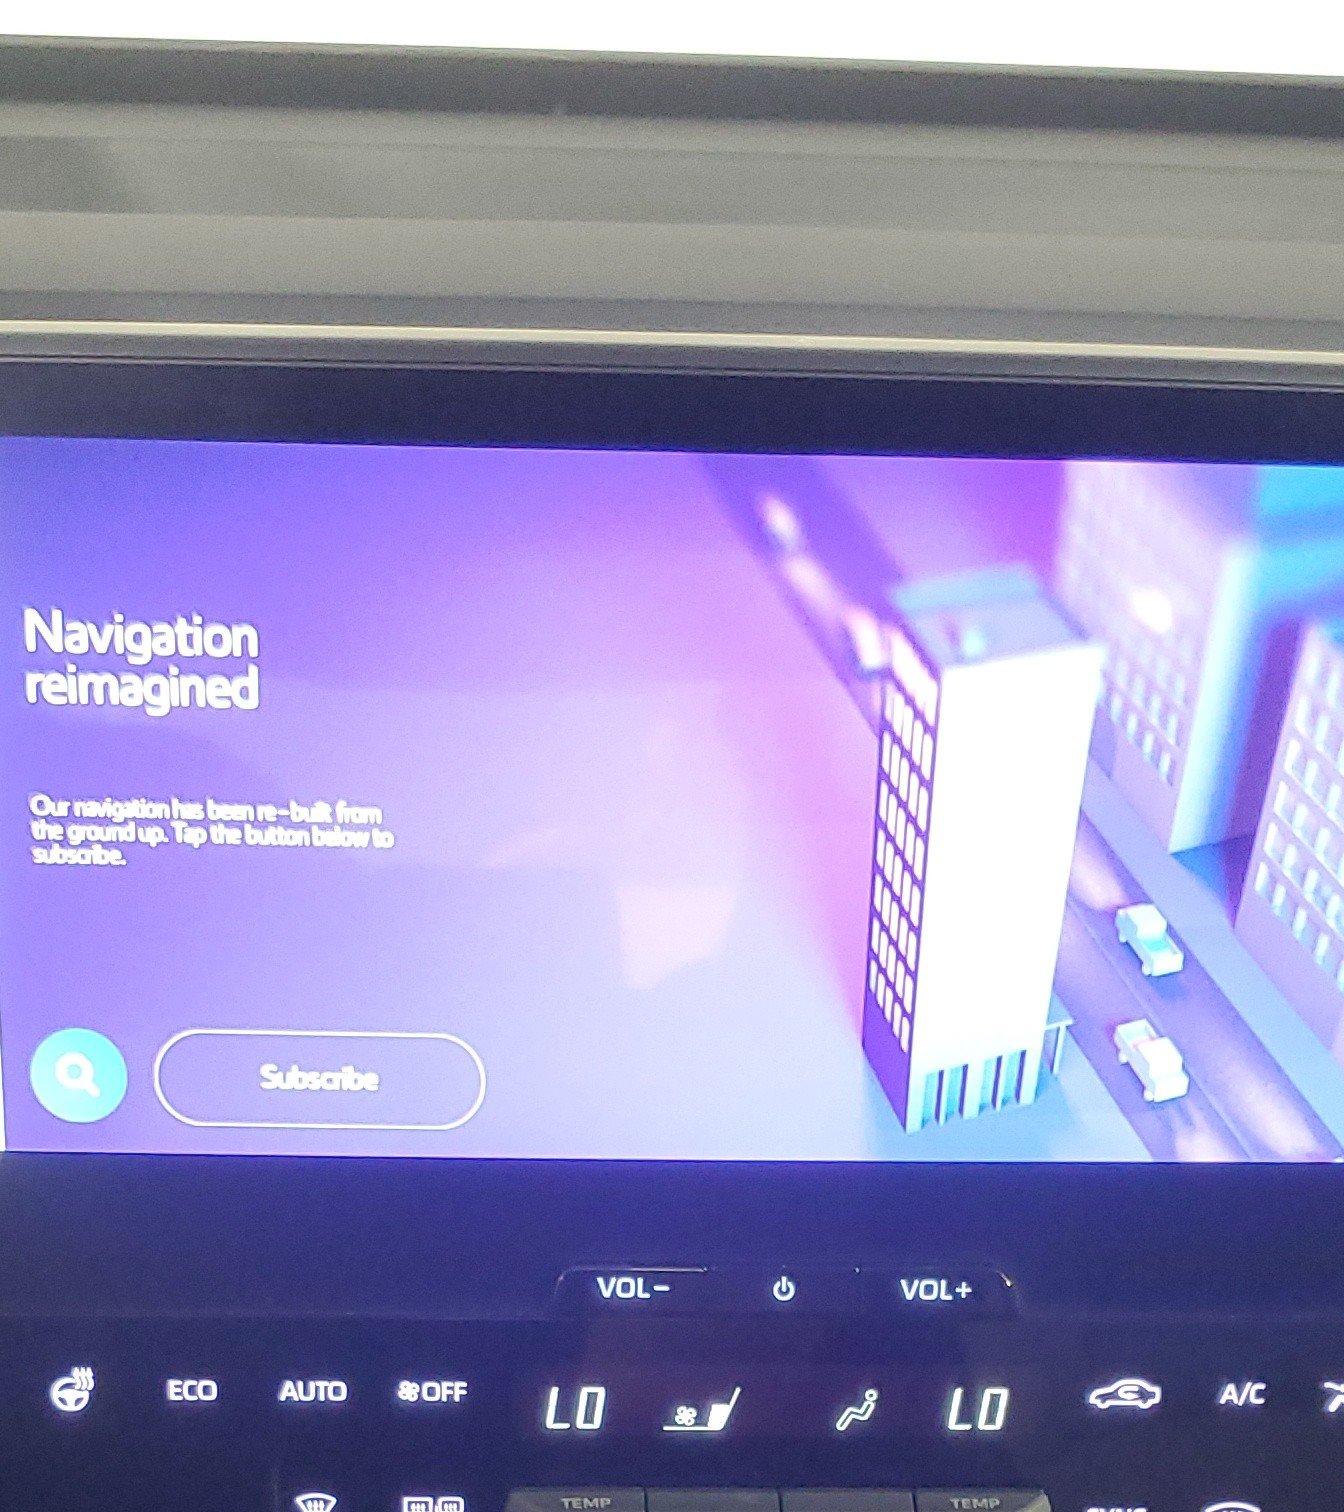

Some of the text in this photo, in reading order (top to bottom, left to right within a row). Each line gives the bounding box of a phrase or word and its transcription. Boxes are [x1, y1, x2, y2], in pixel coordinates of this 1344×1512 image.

[22, 604, 259, 665] Navigation
[24, 661, 259, 716] reimagined
[29, 793, 382, 824] Our navigation has been re-built from
[31, 818, 395, 848] the ground up. Tap the button below to
[31, 843, 127, 865] subscribe.
[260, 1063, 379, 1091] Subscribe
[167, 1380, 218, 1401] ECO
[280, 1380, 348, 1402] AUTO
[422, 1381, 468, 1402] OFF
[1219, 1382, 1266, 1406] A/C
[545, 1386, 606, 1431] LO
[947, 1386, 1009, 1431] LO
[560, 1497, 611, 1511] TEMP
[950, 1497, 1000, 1511] TEMP
